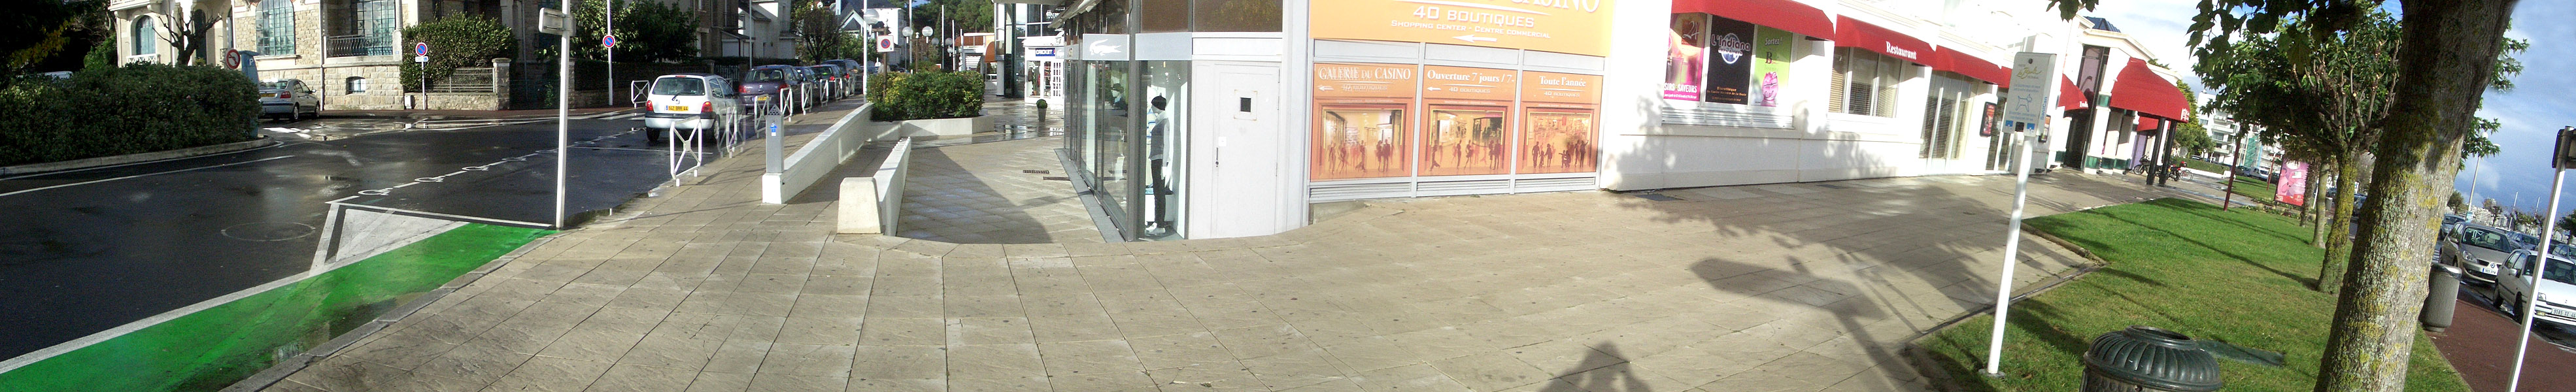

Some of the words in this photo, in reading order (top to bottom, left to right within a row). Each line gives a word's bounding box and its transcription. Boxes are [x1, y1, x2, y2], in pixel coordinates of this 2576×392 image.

[1413, 5, 1440, 20] 40
[1447, 10, 1535, 27] BOUTIQUES
[1711, 34, 1751, 52] L'Indiana
[1886, 41, 1917, 60] Restaurant
[1318, 67, 1359, 80] GALERIE
[1374, 67, 1411, 80] CASINO
[1427, 70, 1470, 81] Ouverture
[1472, 73, 1478, 82] 7
[1479, 73, 1500, 84] jours
[1539, 75, 1560, 85] Toute
[1561, 76, 1587, 87] l'année
[1677, 84, 1697, 93] SAVEURS
